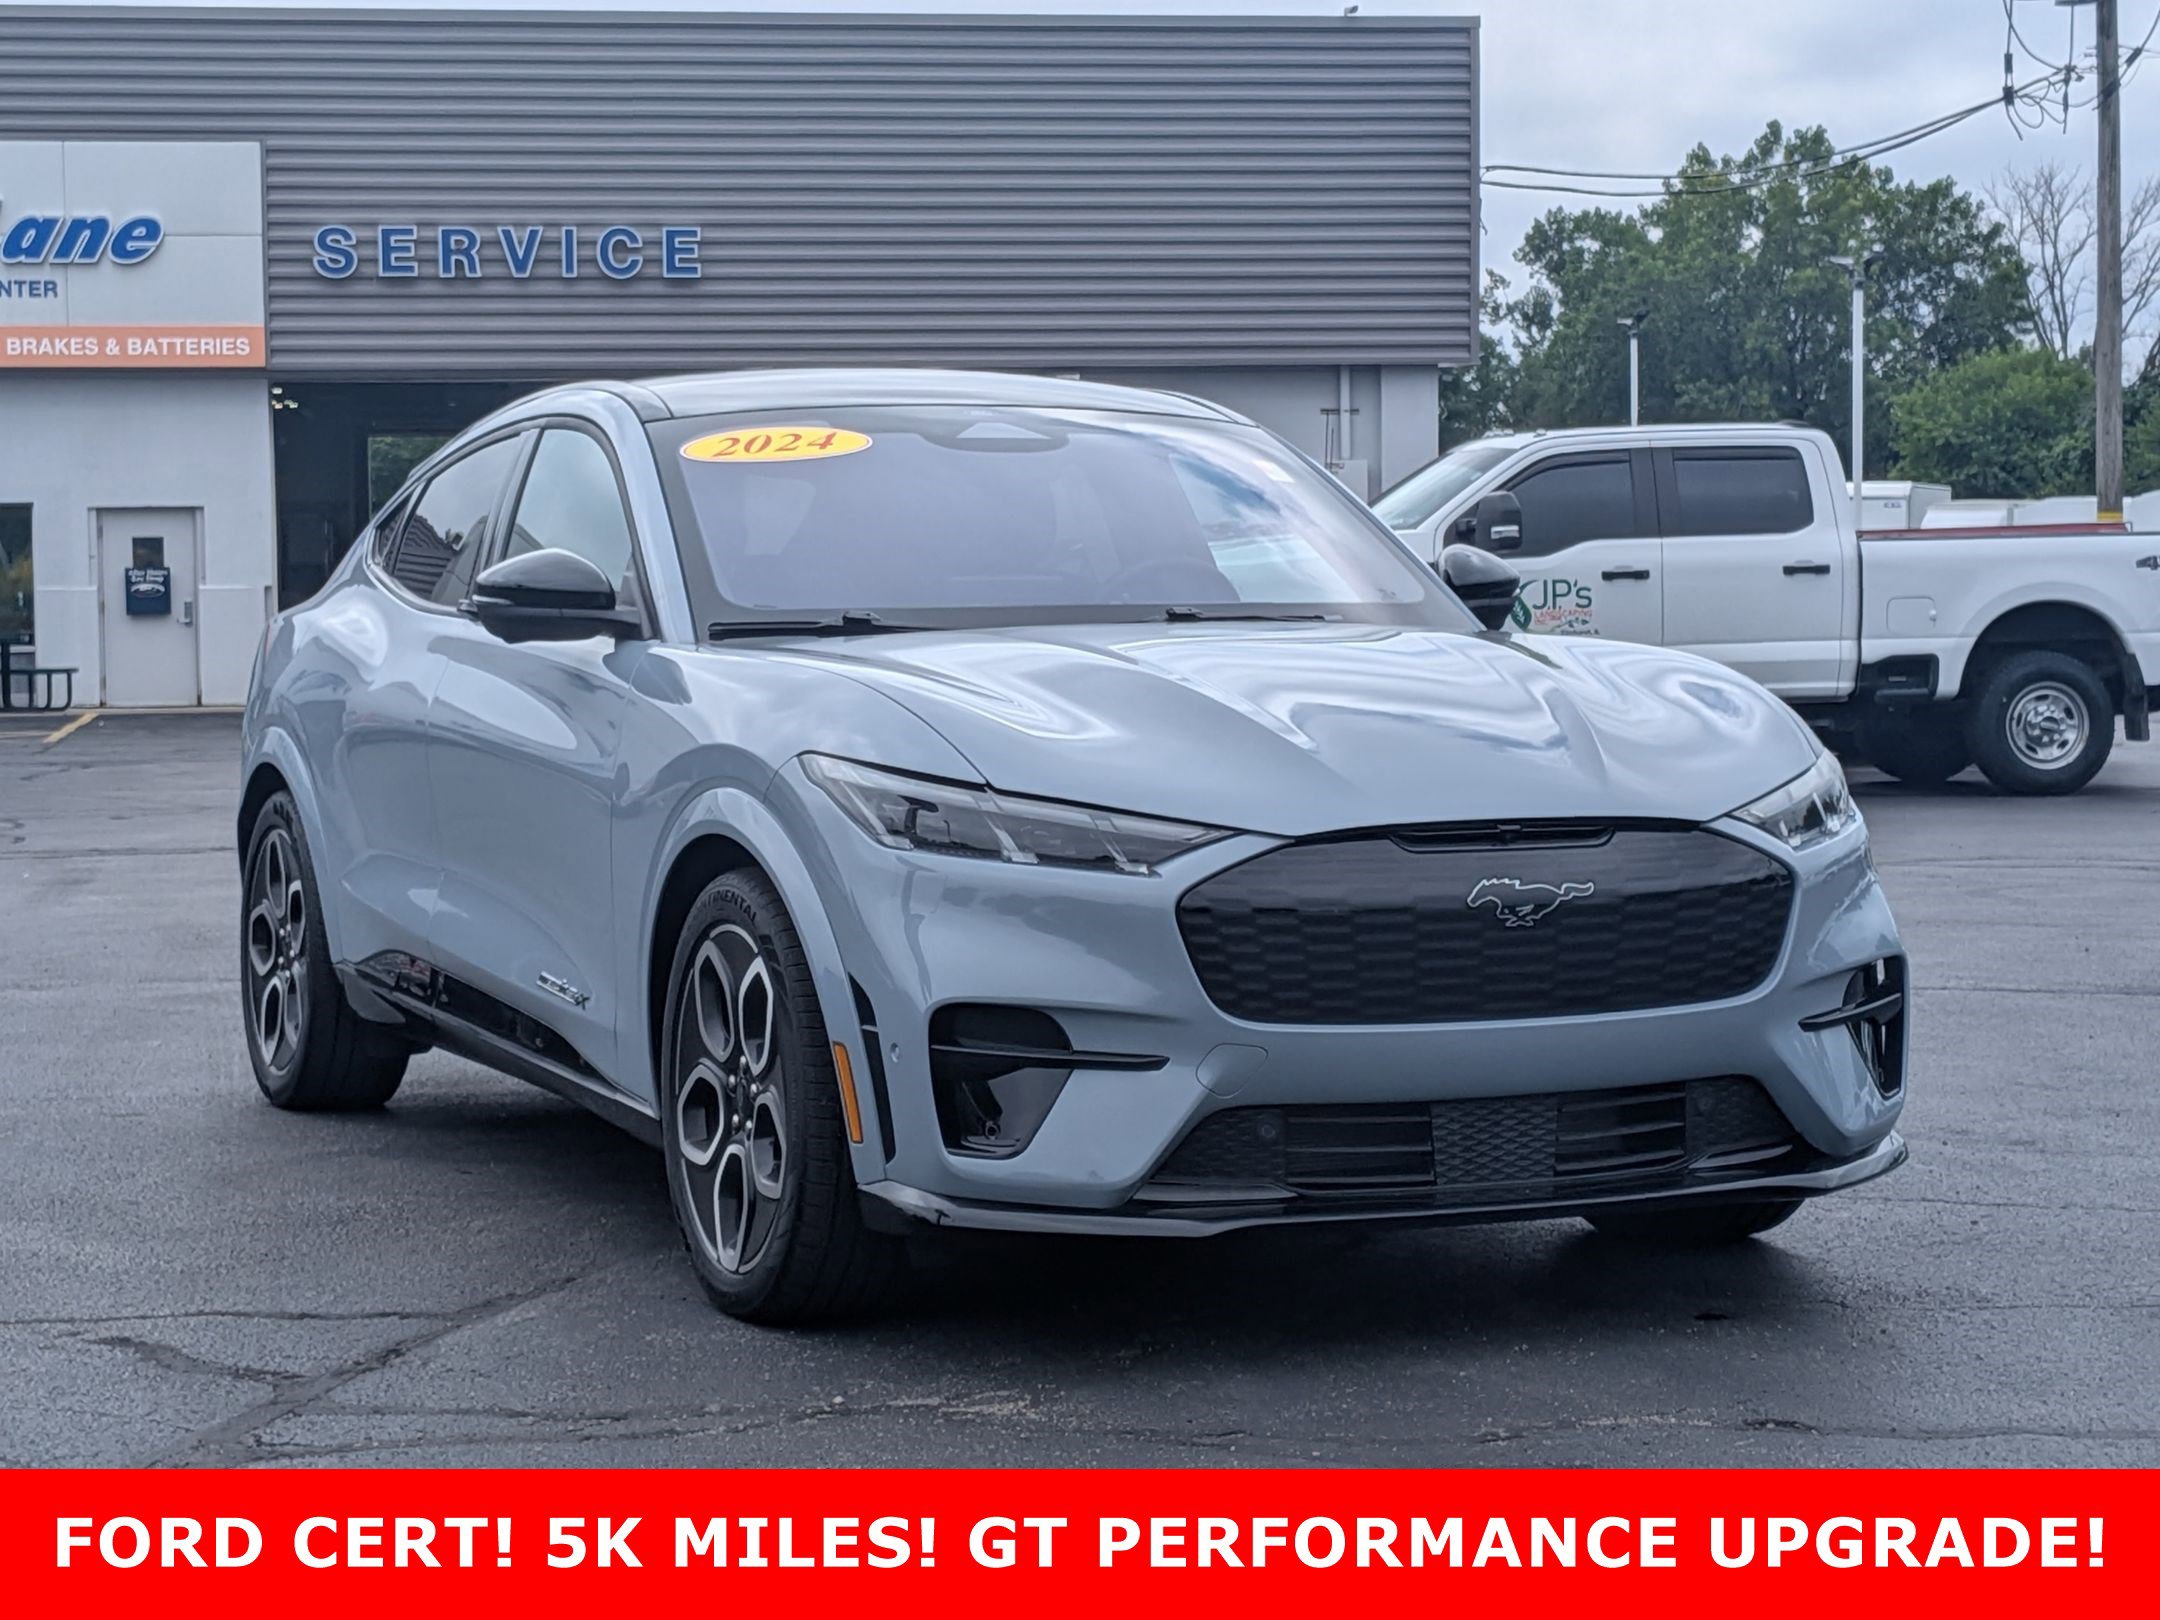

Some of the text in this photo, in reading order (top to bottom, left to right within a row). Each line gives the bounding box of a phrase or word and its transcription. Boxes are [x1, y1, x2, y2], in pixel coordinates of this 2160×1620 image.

[0, 213, 165, 264] ane
[313, 225, 702, 279] SERVICE
[6, 337, 250, 355] BRAKES & BATTERIES
[711, 431, 838, 458] 2024
